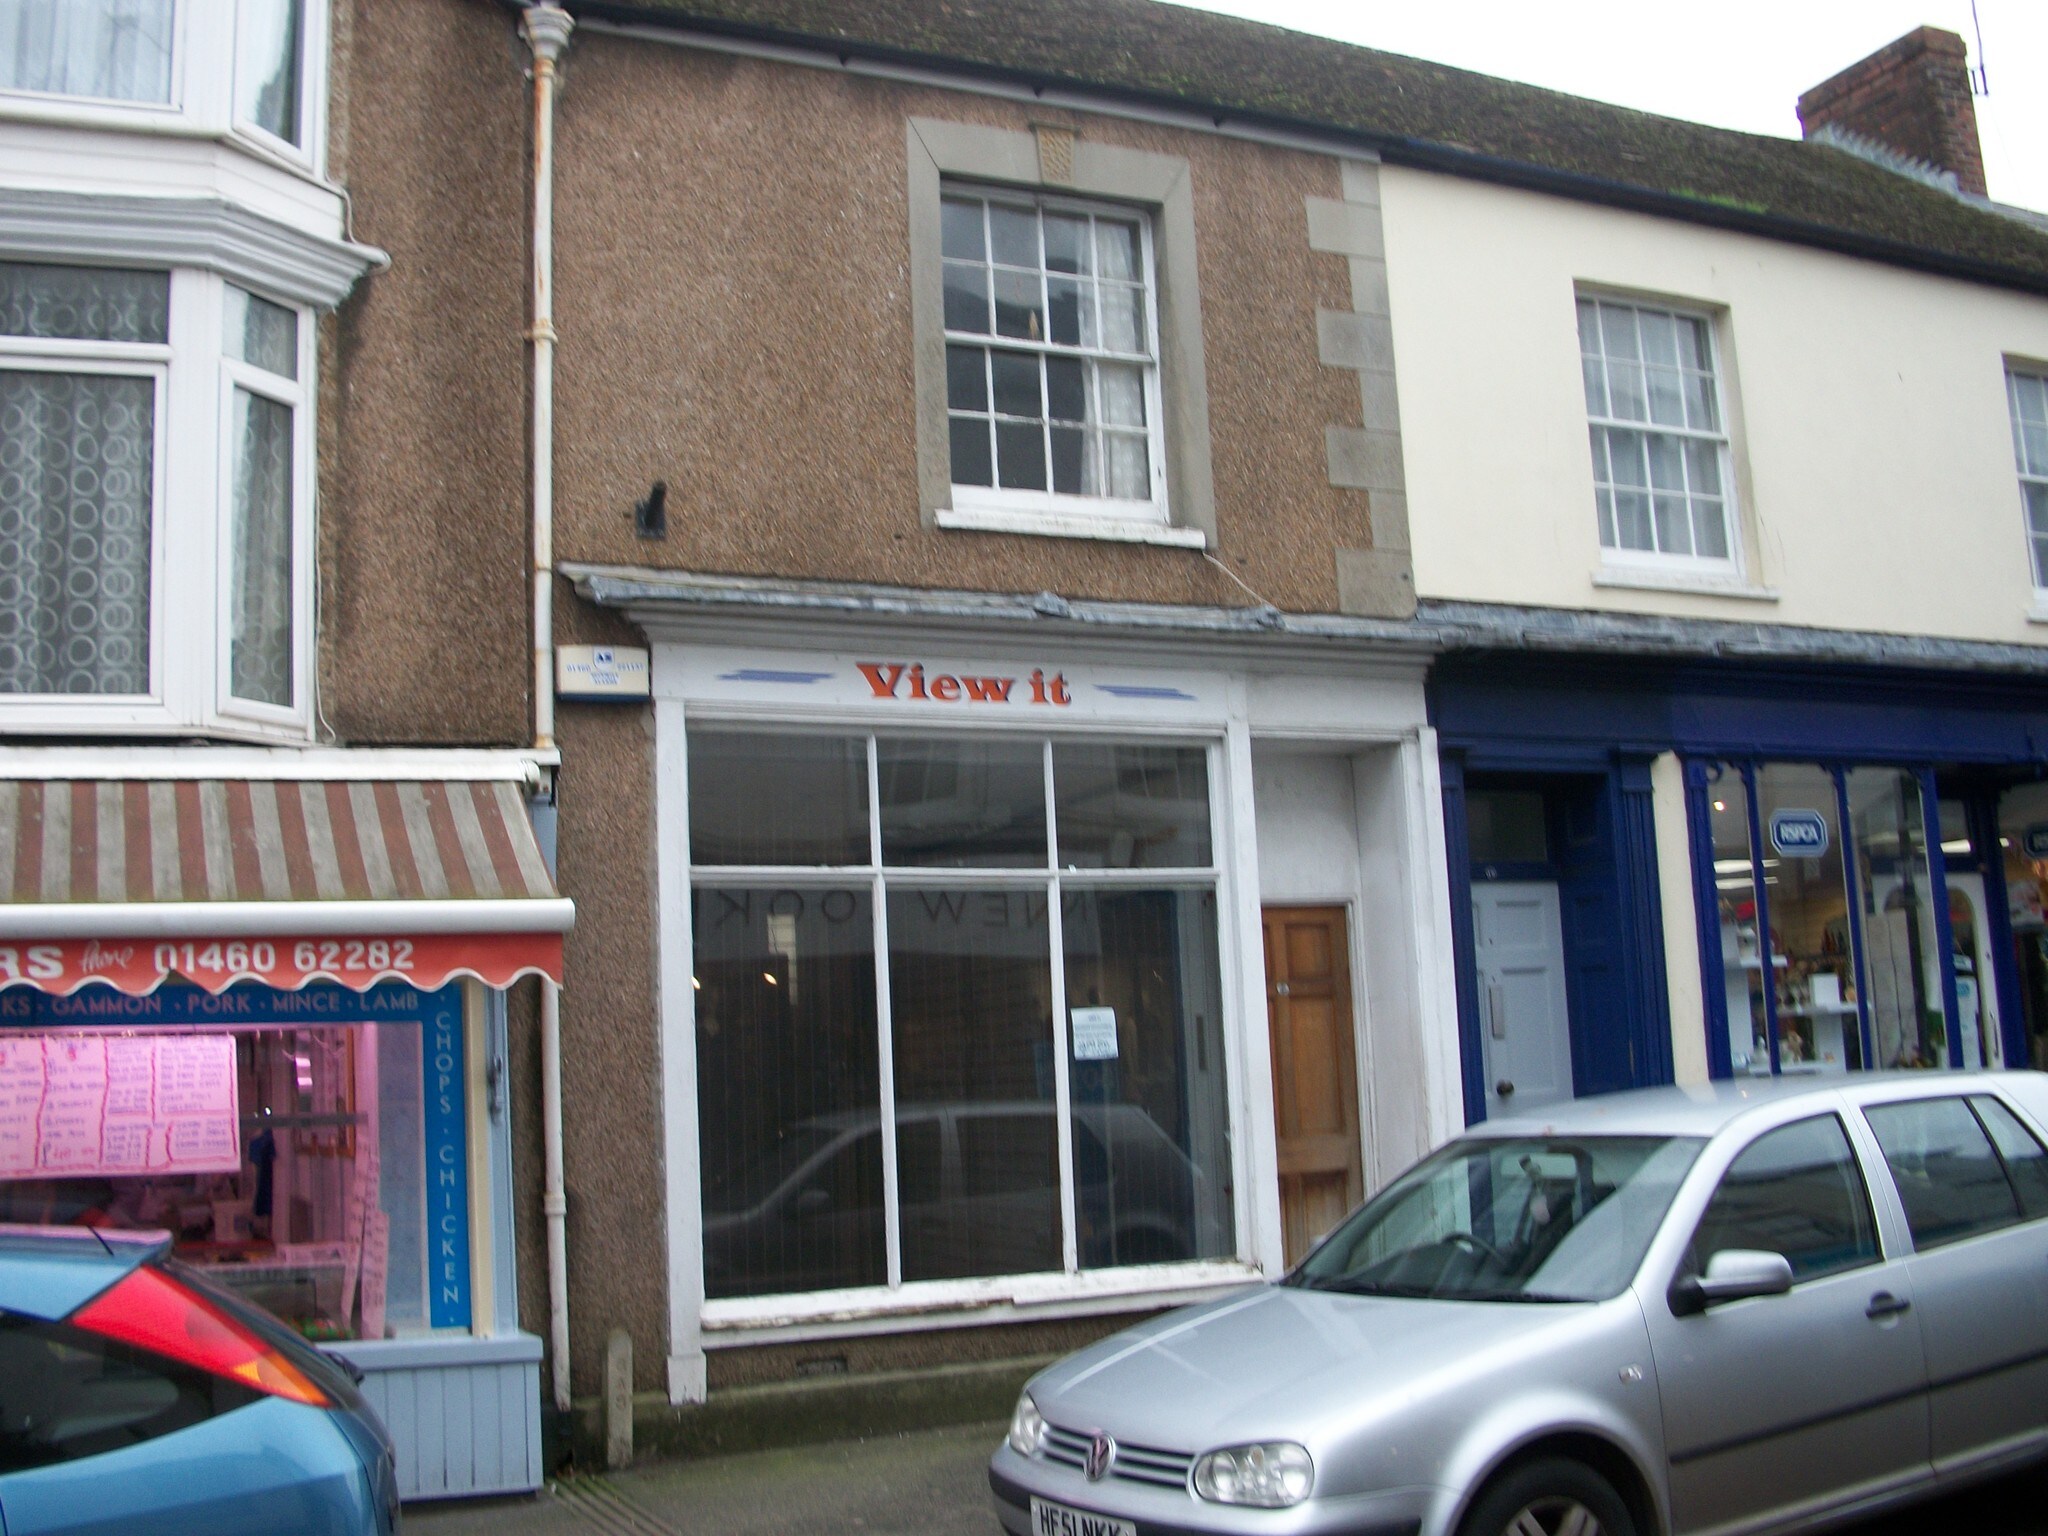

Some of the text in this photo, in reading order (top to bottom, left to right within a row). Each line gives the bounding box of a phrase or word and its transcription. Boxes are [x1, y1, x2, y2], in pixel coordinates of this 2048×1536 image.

[855, 661, 1073, 707] View it
[154, 942, 276, 974] 01460
[294, 940, 415, 972] 62282
[52, 993, 162, 1017] GAMMON
[187, 991, 251, 1015] PORK
[272, 991, 341, 1013] MINCE
[360, 989, 419, 1011] LAMB
[434, 1010, 455, 1114] CHOPS
[439, 1144, 460, 1305] CHICKEN
